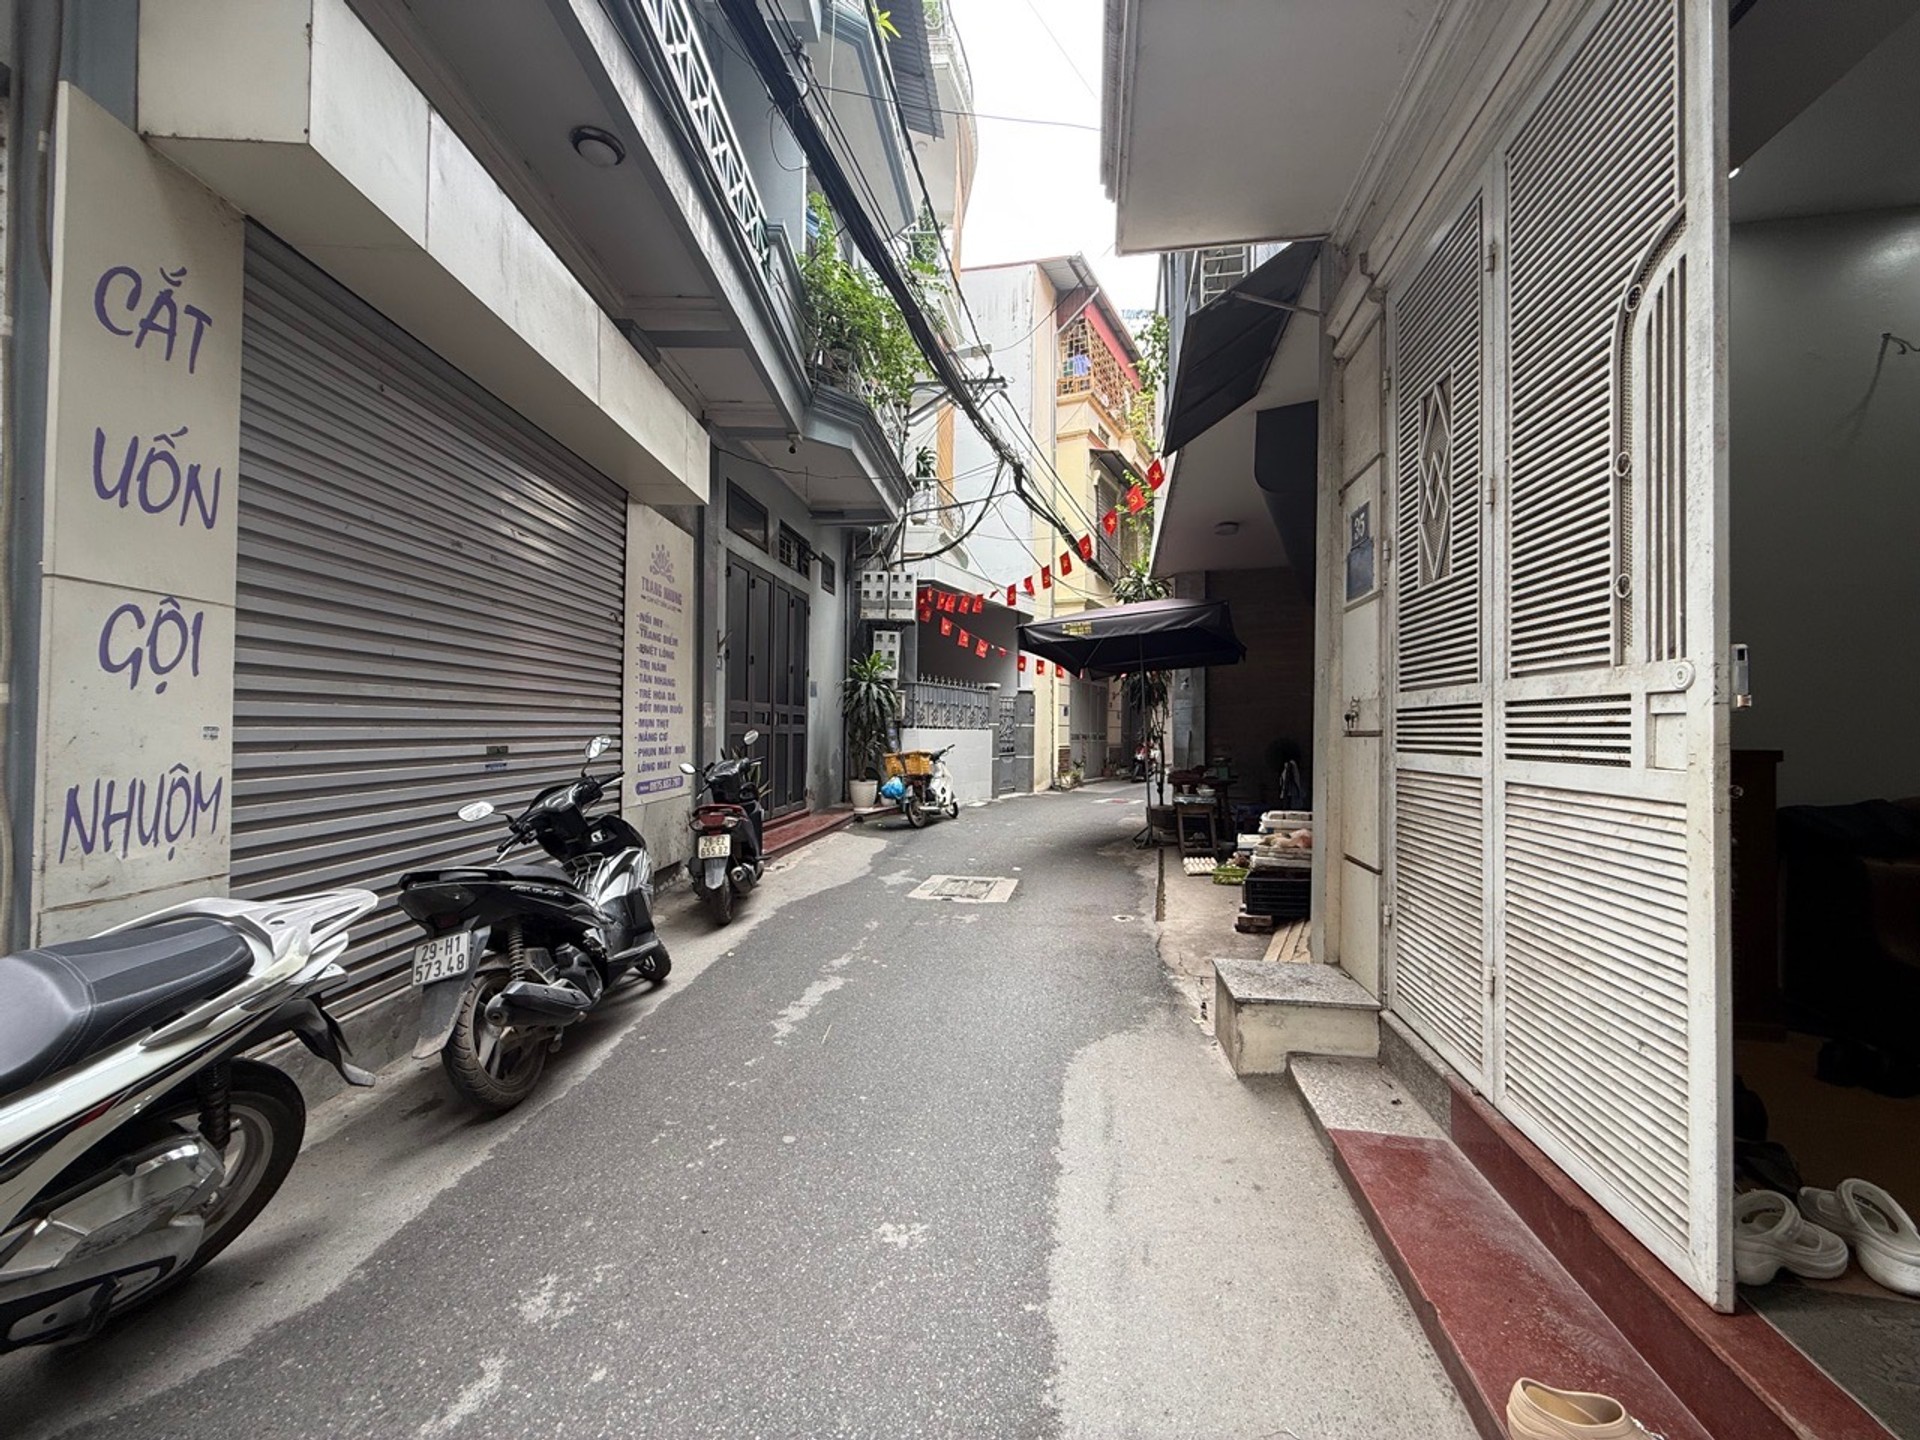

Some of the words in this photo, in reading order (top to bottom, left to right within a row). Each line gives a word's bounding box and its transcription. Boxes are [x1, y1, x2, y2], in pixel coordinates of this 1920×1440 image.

[95, 266, 212, 374] CẮT
[93, 426, 221, 530] UỐN
[1354, 512, 1365, 540] 35
[99, 596, 204, 694] GỘI
[59, 762, 223, 864] NHUỘM
[415, 953, 465, 983] 573.48
[421, 936, 461, 963] 29-H1
